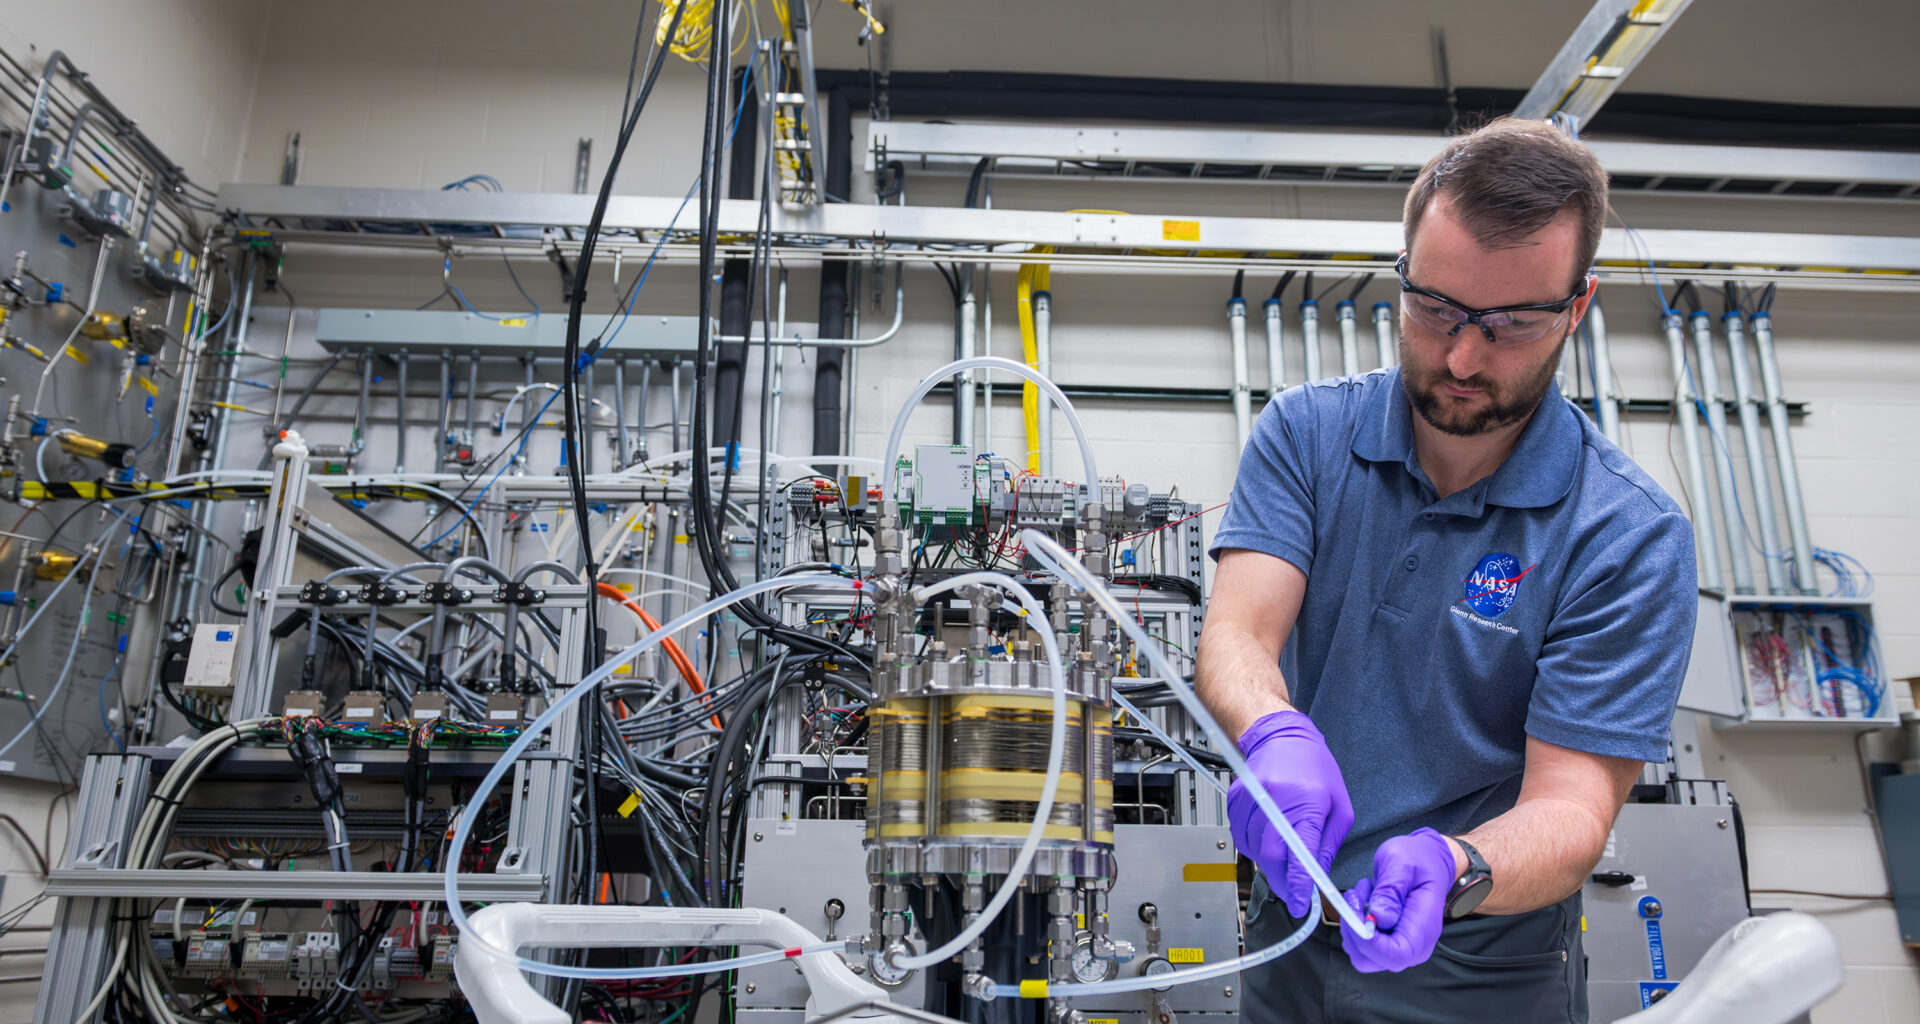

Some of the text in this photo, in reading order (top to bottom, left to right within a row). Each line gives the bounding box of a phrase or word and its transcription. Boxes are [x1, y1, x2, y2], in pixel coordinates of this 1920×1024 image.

[1470, 571, 1517, 597] NASA
[1450, 605, 1519, 634] Glenn Research Center
[1170, 949, 1202, 962] HR001
